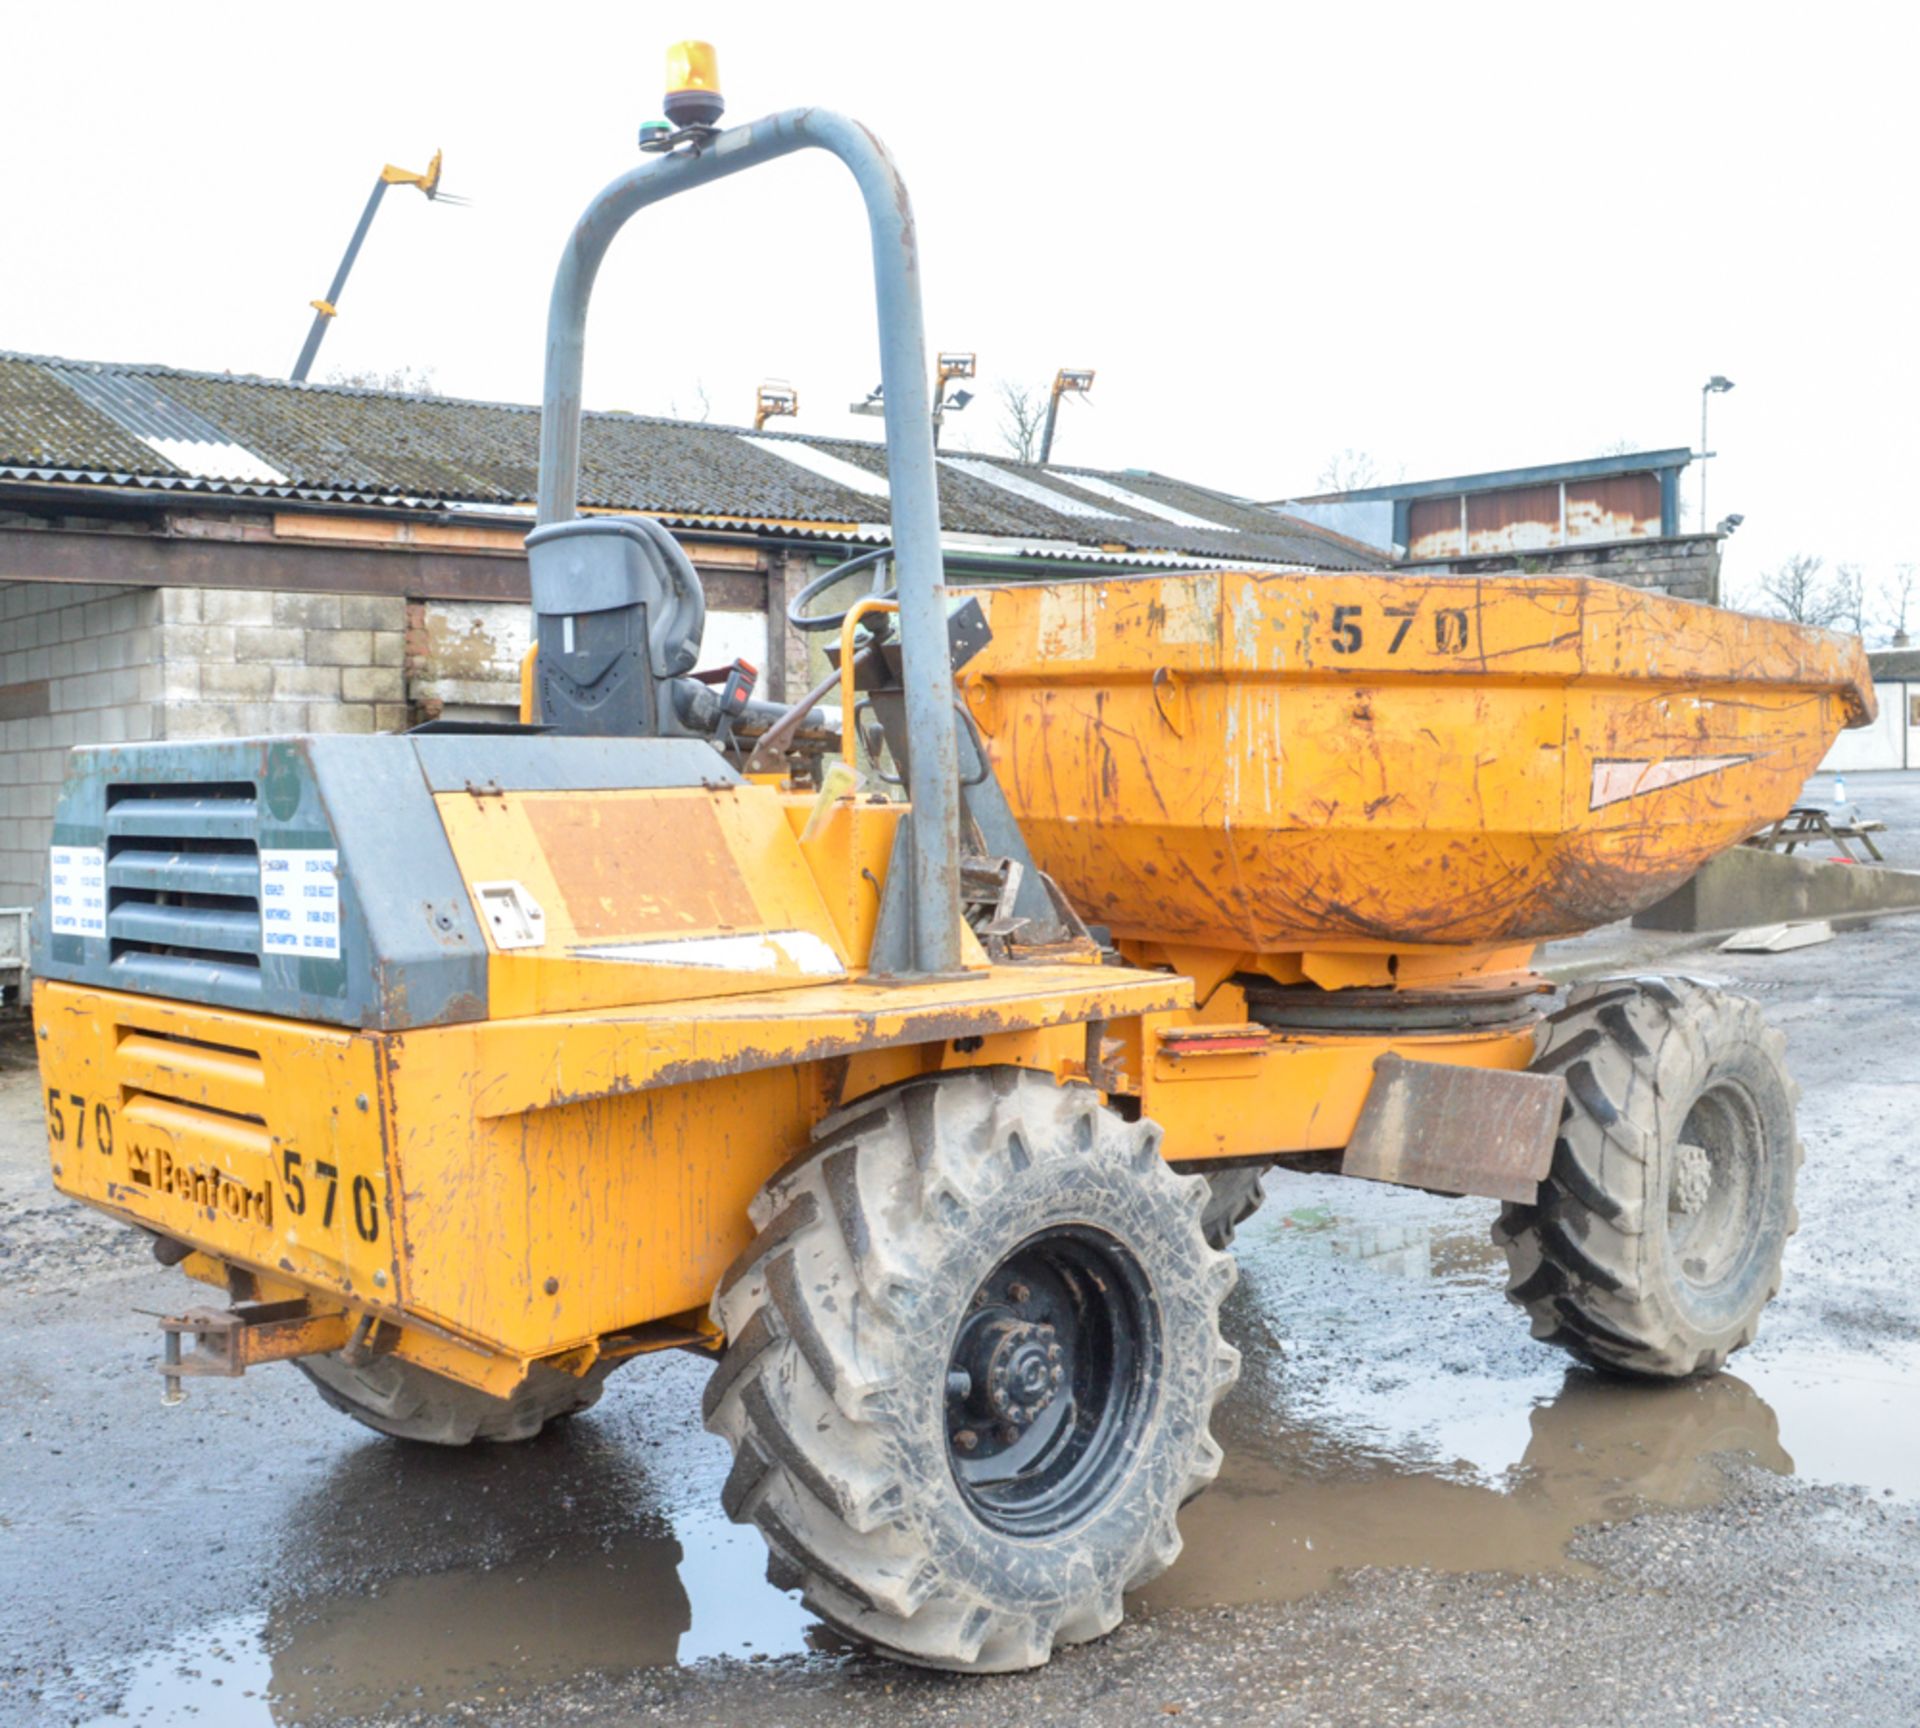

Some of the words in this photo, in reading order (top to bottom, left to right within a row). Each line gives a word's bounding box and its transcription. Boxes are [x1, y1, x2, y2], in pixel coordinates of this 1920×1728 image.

[1331, 605, 1468, 653] 570
[49, 1087, 114, 1155] 570
[155, 1148, 273, 1226] Benford
[283, 1149, 379, 1242] 570
